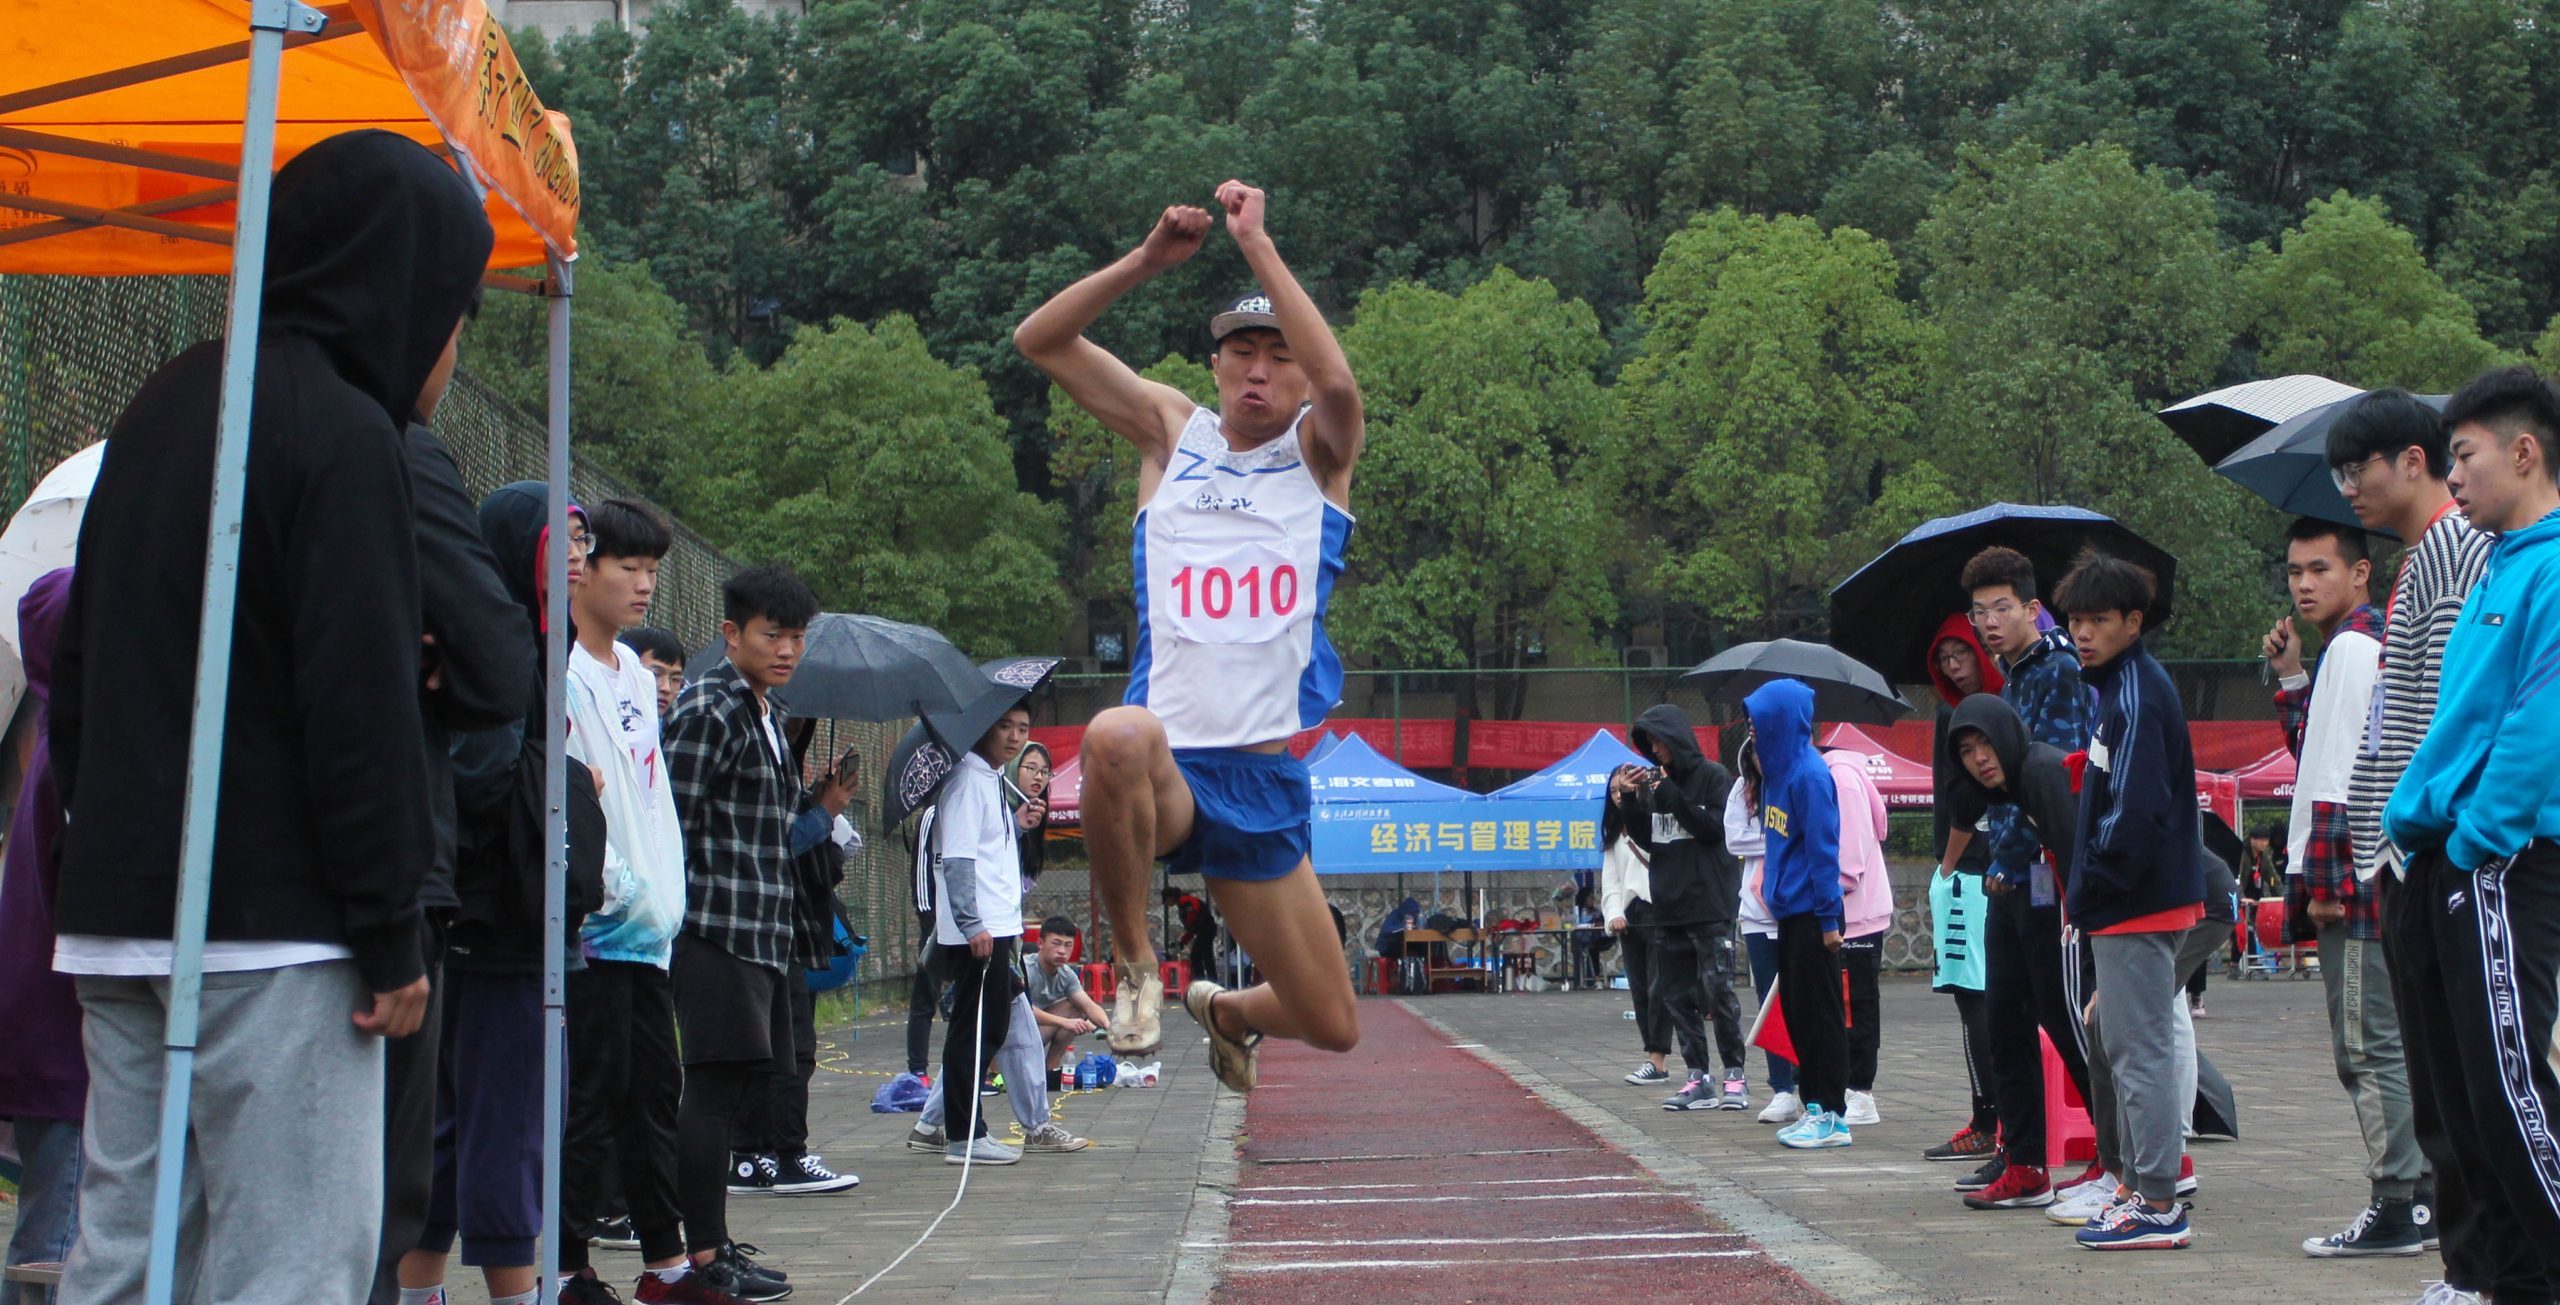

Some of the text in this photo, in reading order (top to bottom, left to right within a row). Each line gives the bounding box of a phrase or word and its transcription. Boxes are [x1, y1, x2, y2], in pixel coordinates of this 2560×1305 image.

[1171, 564, 1298, 619] 1010
[1370, 820, 1596, 854] 经济与管理学院
[2494, 958, 2512, 1027] LI-NING
[2519, 1096, 2553, 1162] LI-NING
